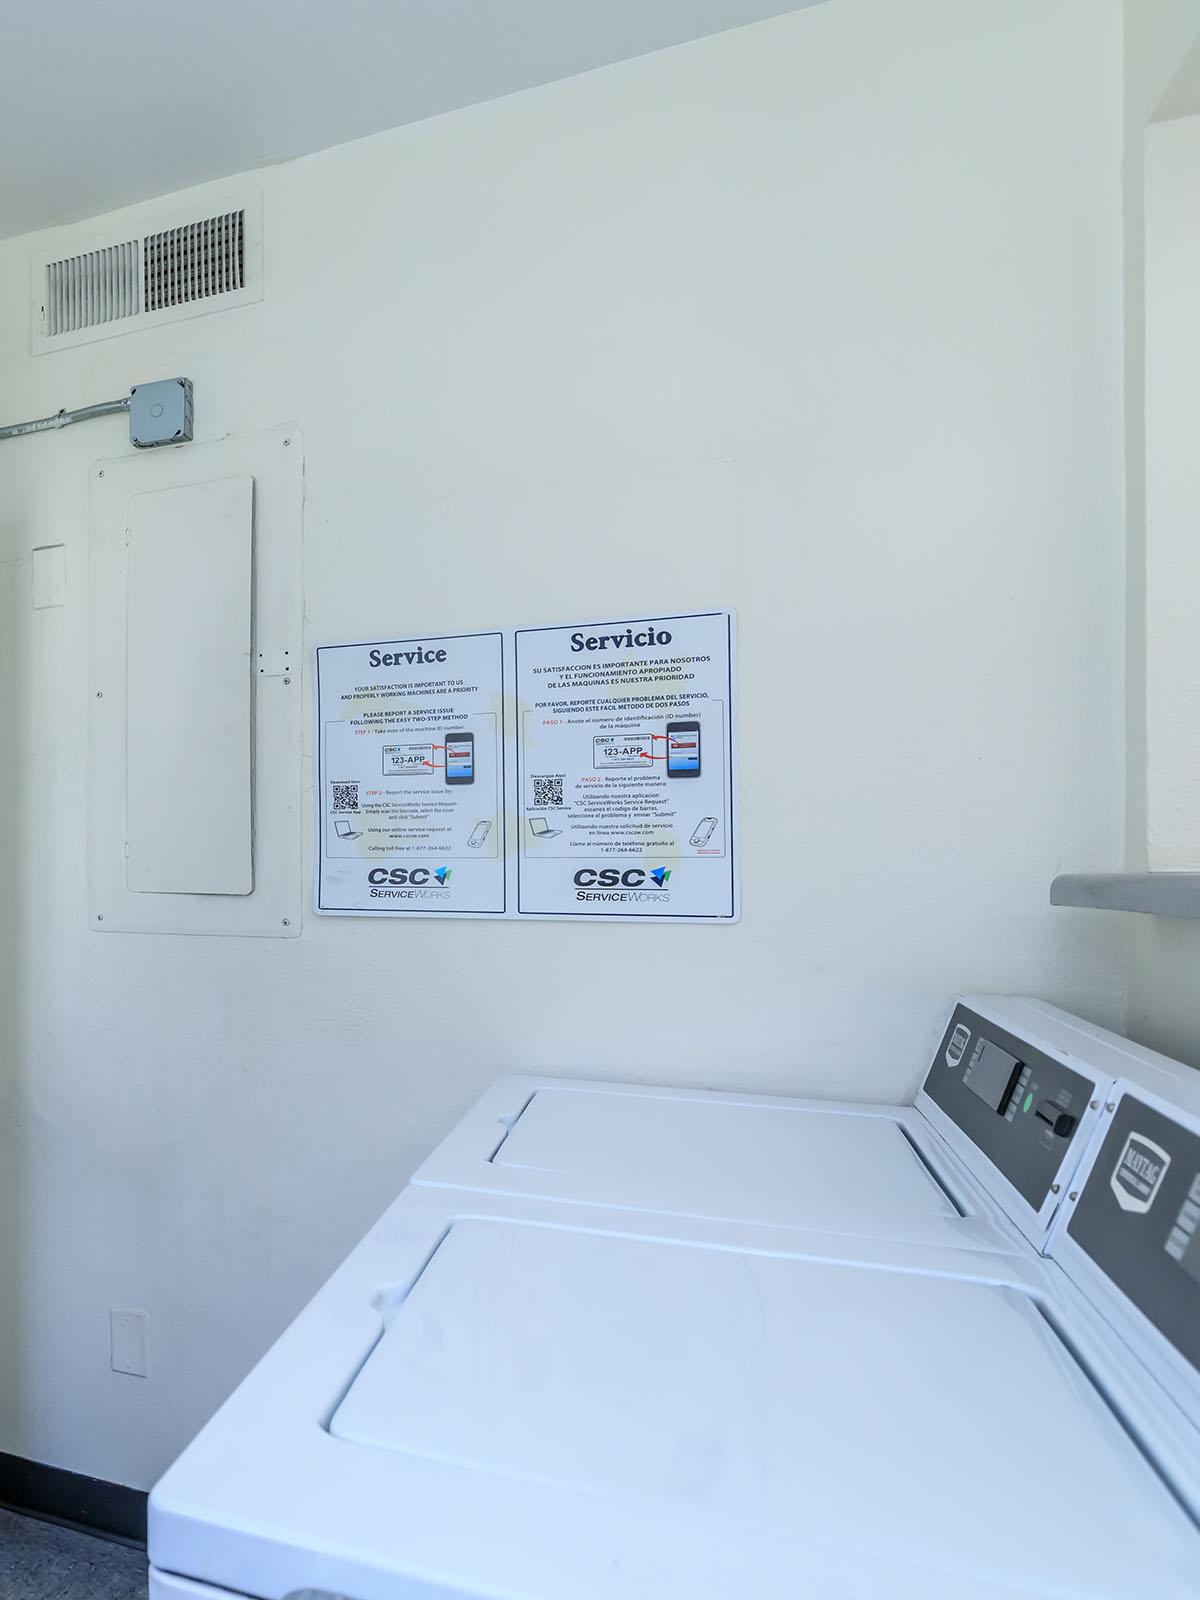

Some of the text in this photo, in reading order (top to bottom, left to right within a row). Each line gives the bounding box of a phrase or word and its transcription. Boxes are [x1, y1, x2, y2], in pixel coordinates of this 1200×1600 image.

[571, 627, 672, 652] Servicio
[369, 647, 447, 668] Service
[542, 664, 591, 673] SATISFACCION
[601, 660, 648, 669] IMPORTANTE
[669, 656, 711, 664] NOSOTROS
[573, 669, 639, 679] FUNCIONAMIENTO
[638, 666, 681, 674] APROPIADO
[369, 683, 407, 691] SATISFACTION
[571, 679, 609, 687] MAQUINAS
[620, 676, 652, 684] NUESTRA
[653, 674, 694, 682] PRIORIDAD
[596, 697, 630, 705] CUALQUIER
[631, 695, 665, 703] PROBLEMA
[603, 747, 643, 756] 123-APP
[391, 756, 426, 764] 123-APP
[368, 868, 430, 885] CSC
[574, 869, 645, 887] CSC
[1124, 1147, 1162, 1184] MAYTAG
